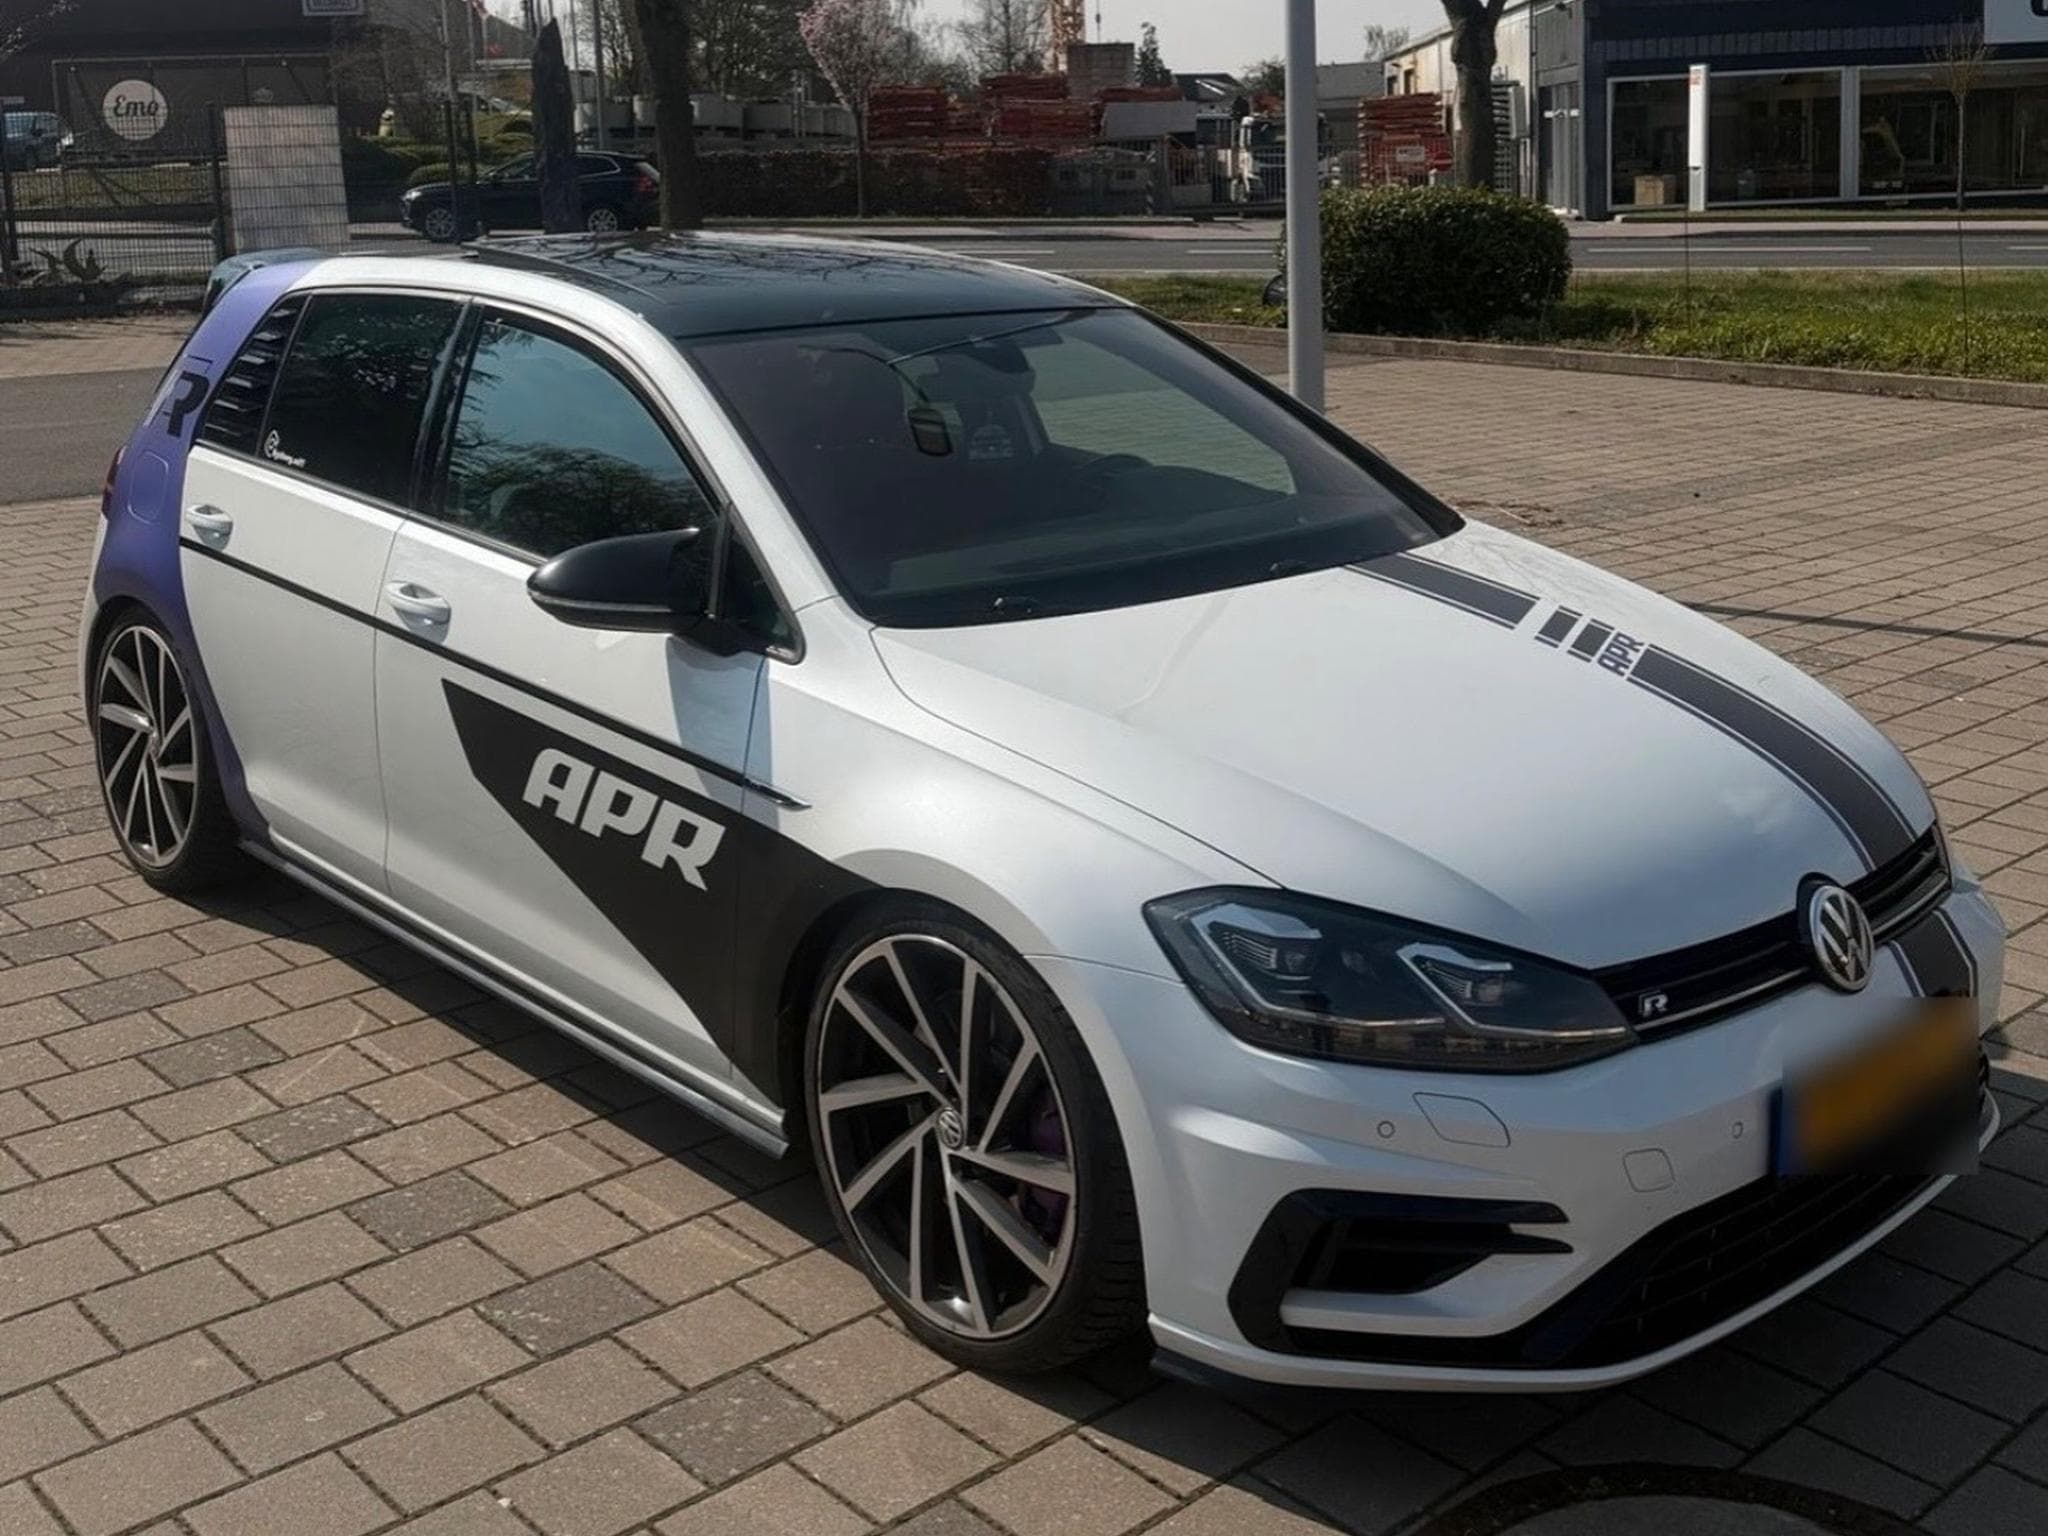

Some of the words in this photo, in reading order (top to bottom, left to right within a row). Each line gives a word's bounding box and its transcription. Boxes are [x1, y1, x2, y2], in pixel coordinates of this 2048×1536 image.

[1597, 631, 1645, 676] APR
[522, 748, 726, 891] APR
[1638, 991, 1669, 1018] R
